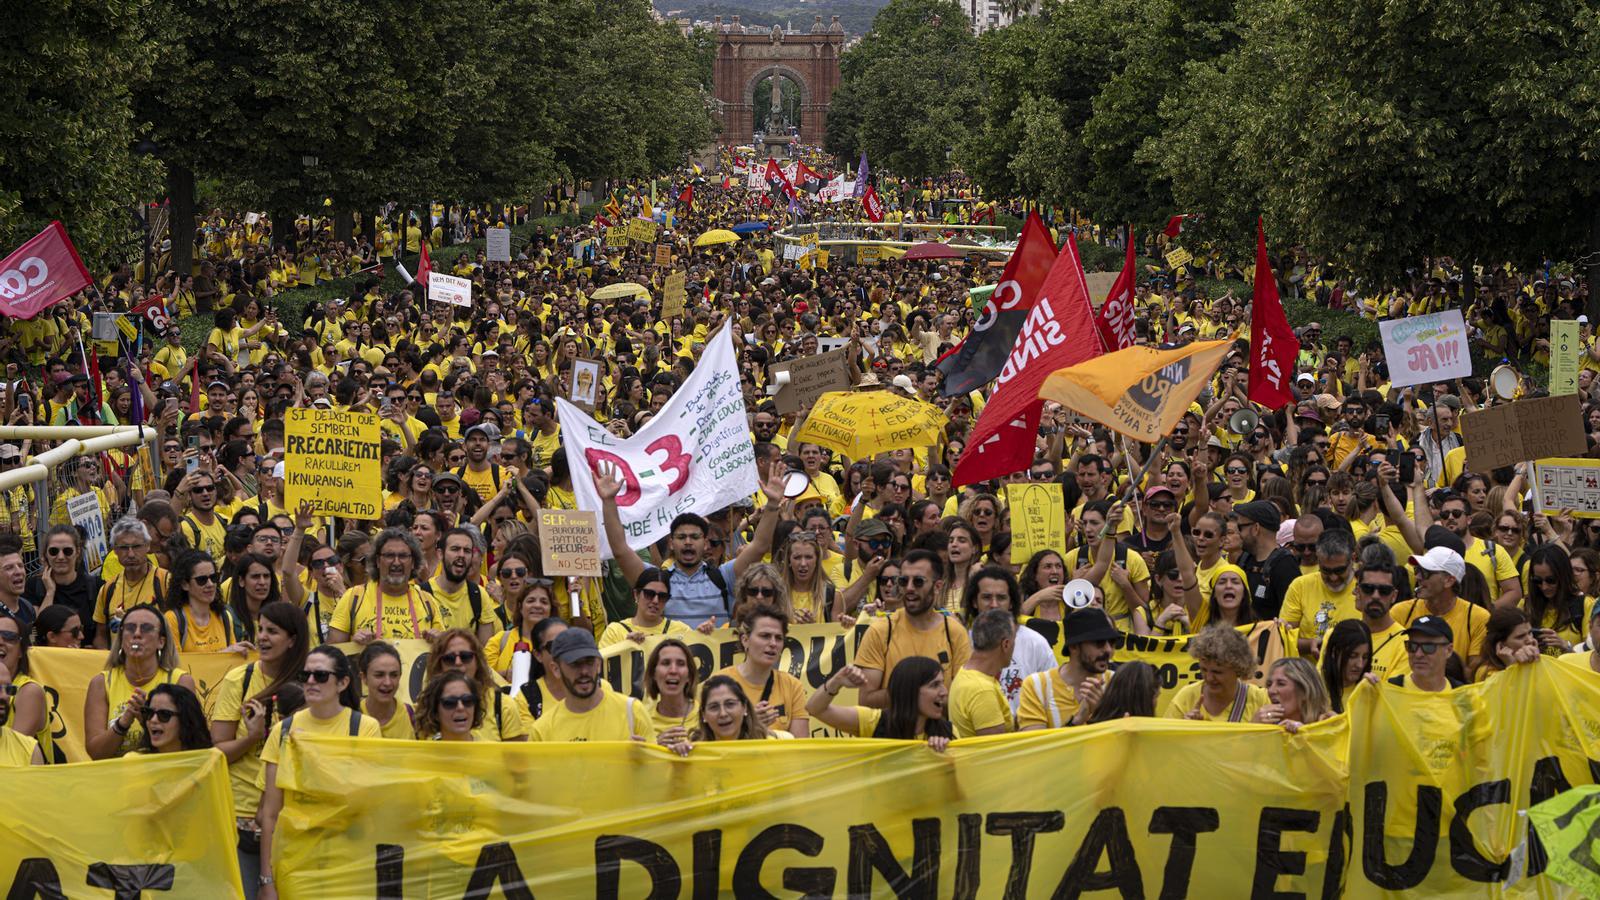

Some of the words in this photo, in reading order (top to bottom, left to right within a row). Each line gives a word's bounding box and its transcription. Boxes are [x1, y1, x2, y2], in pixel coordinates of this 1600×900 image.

[771, 172, 786, 187] CGT
[803, 173, 820, 186] CGT
[291, 409, 307, 421] SI
[315, 410, 352, 423] DEIXEM
[358, 415, 375, 426] QUE
[310, 423, 360, 437] SEMBRIN
[543, 514, 566, 526] SER
[558, 560, 571, 569] NO
[574, 557, 598, 571] SER
